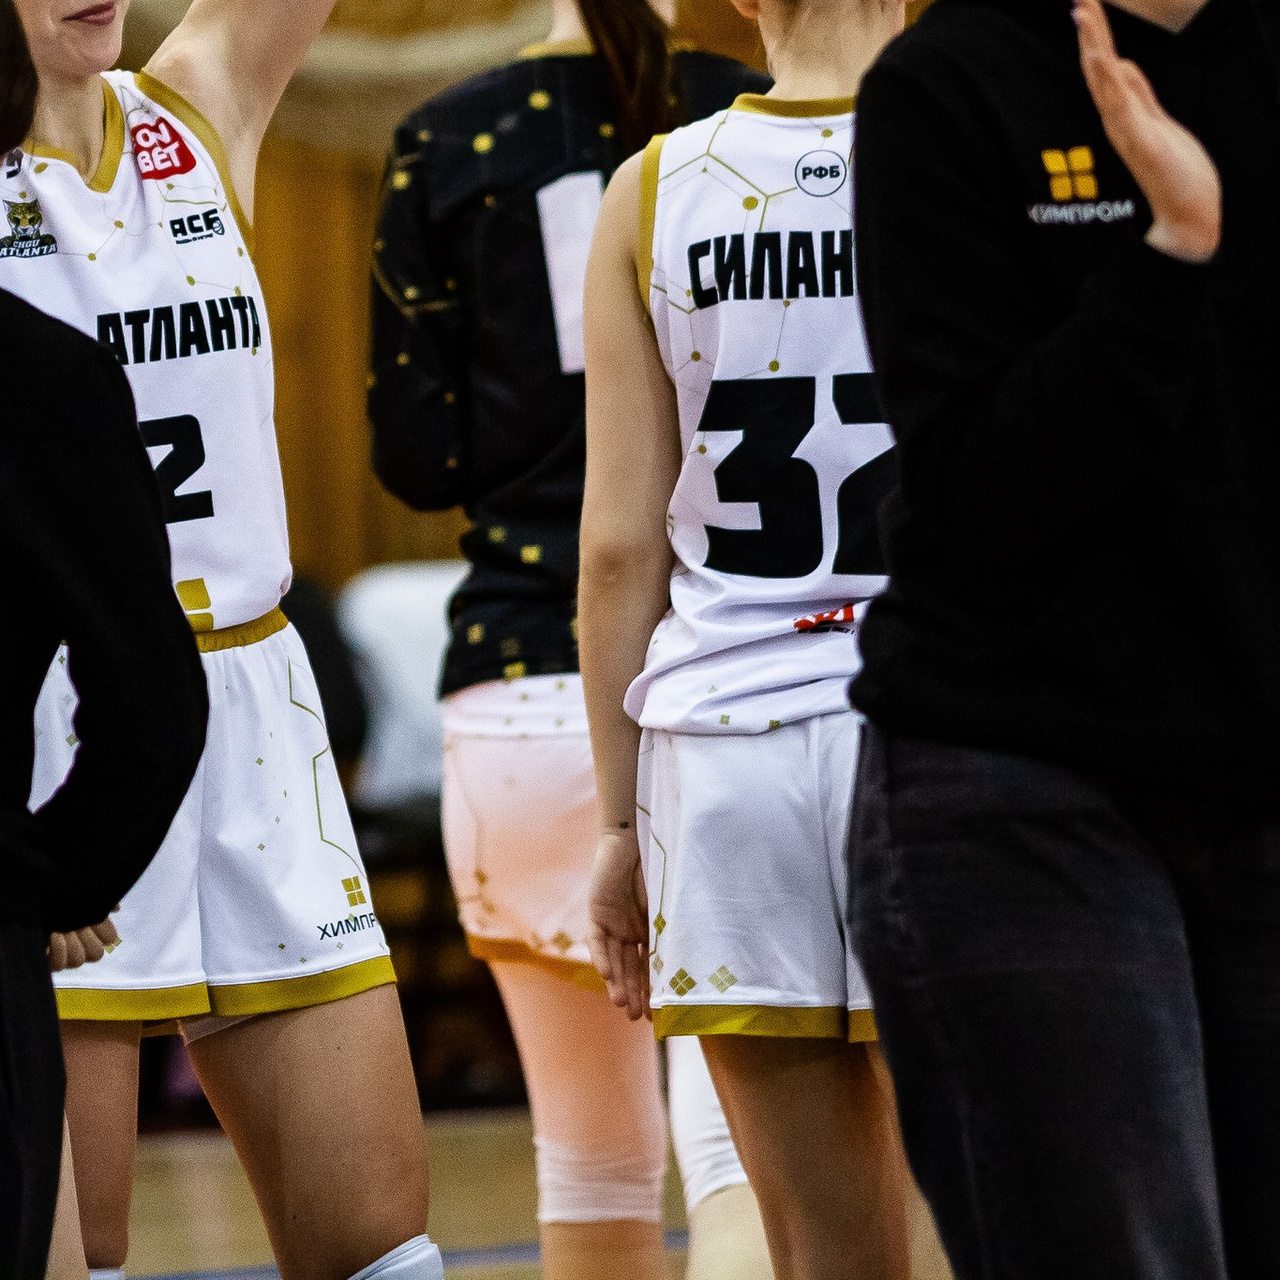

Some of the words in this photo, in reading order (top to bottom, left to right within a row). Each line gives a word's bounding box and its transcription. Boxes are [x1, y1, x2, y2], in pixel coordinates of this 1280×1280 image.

[132, 122, 171, 148] ON
[137, 141, 181, 173] BET
[802, 165, 841, 180] РФБ
[169, 208, 225, 237] АСБ
[687, 229, 854, 310] СИЛАН
[97, 296, 262, 365] АТЛАНТА
[697, 372, 897, 579] 32
